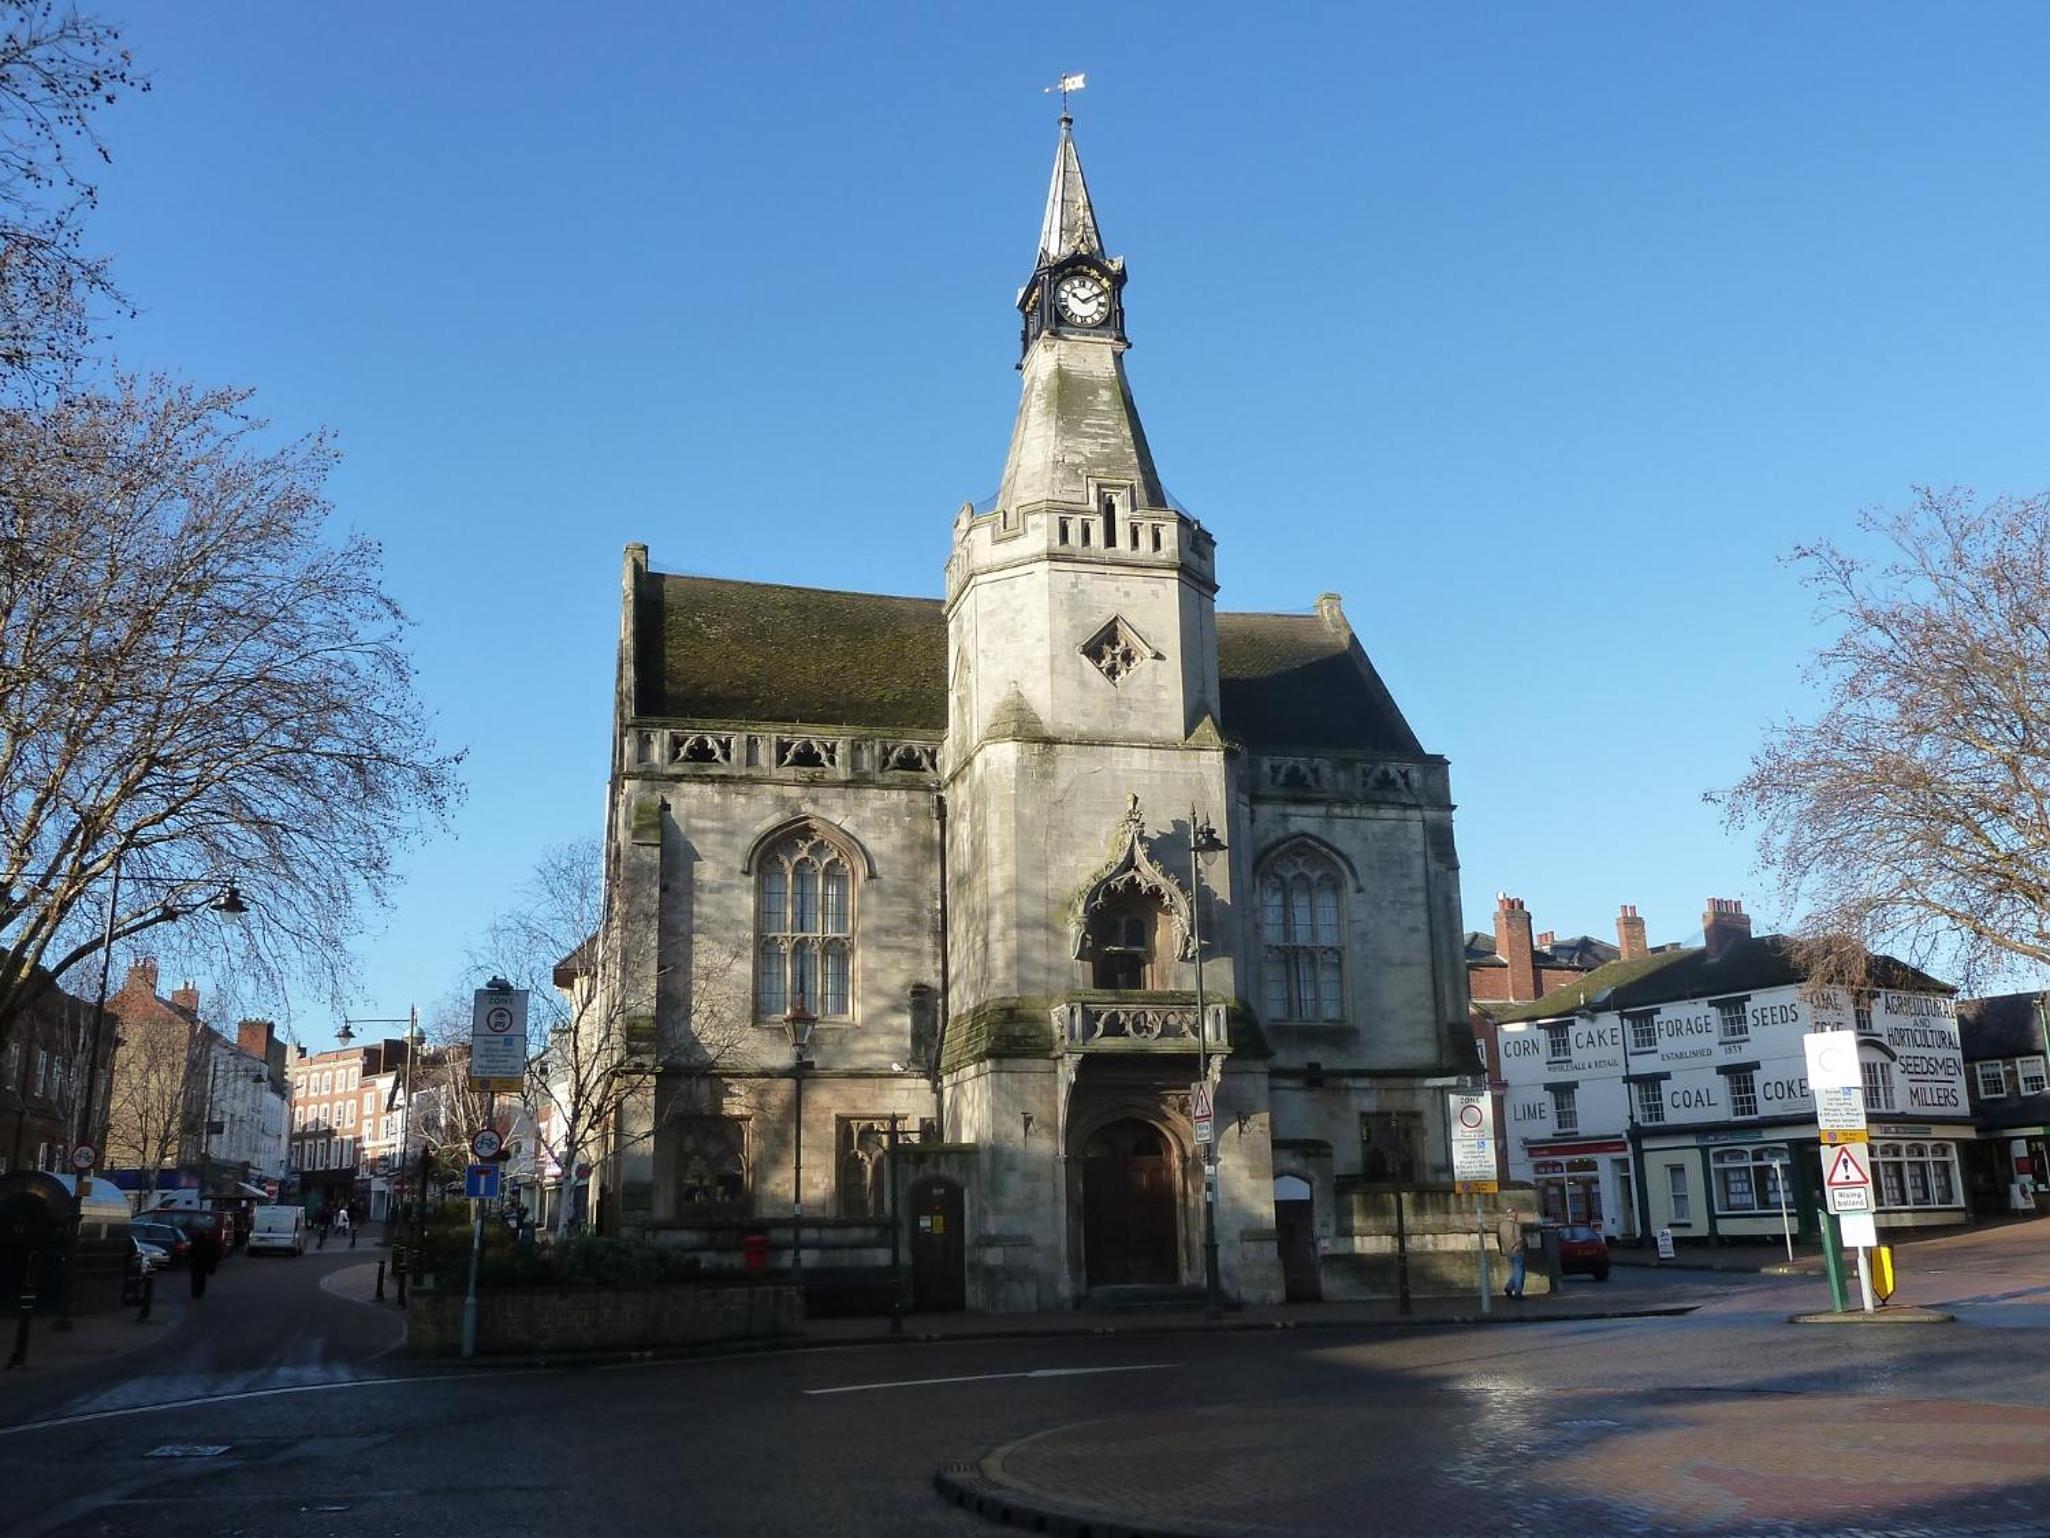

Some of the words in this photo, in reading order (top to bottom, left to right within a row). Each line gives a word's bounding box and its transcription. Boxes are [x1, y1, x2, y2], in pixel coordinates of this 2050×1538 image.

[1752, 1003, 1799, 1027] SEEDS
[1884, 992, 1957, 1018] AGRICULTURAL
[1575, 1027, 1621, 1049] CAKE
[1657, 1015, 1713, 1039] FORAGE
[1504, 1038, 1540, 1058] CORN
[1887, 1027, 1960, 1050] HORTICULTURAL
[1661, 1048, 1712, 1061] ESTABLISHED
[1899, 1055, 1962, 1076] SEEDSMEN
[1460, 1096, 1481, 1104] ZONE
[1670, 1088, 1718, 1109] COAL
[1762, 1078, 1809, 1101] COKE
[1908, 1086, 1959, 1108] MILLERS
[1513, 1102, 1547, 1121] LIME
